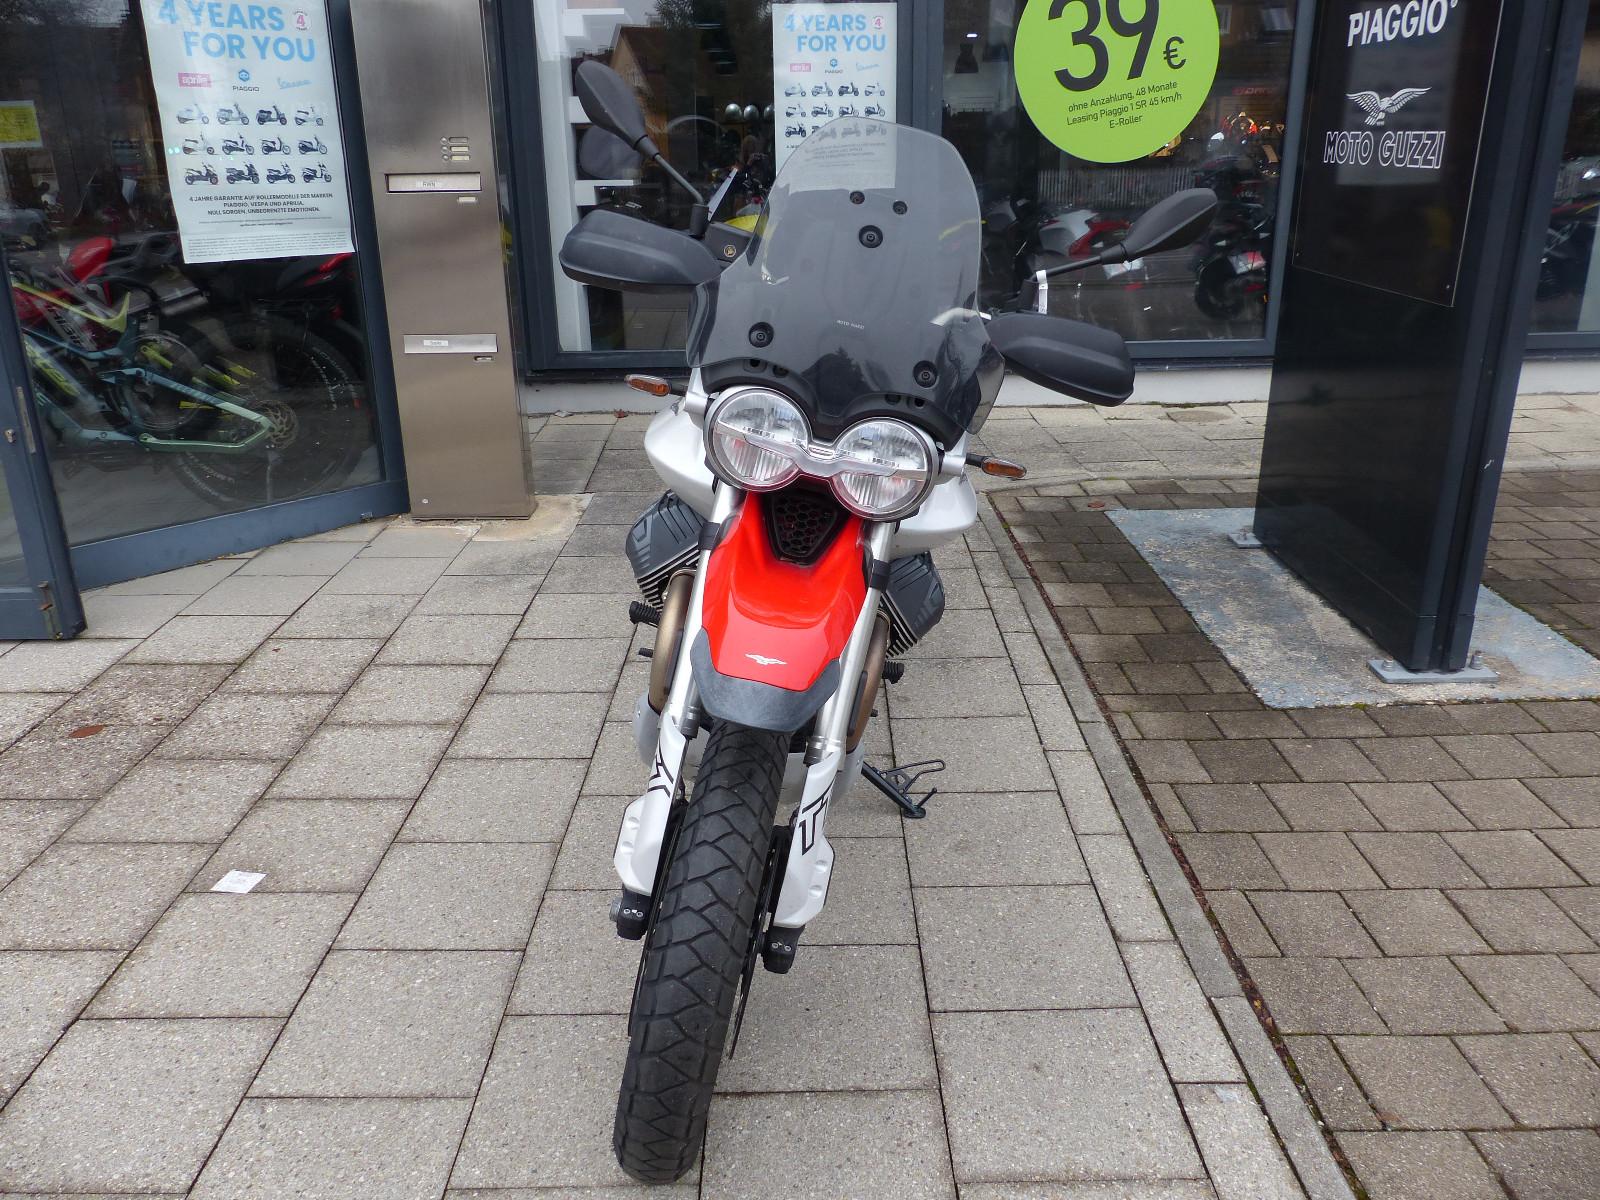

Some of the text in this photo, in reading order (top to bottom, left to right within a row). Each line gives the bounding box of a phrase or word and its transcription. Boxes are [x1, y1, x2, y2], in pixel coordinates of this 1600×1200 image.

[159, 0, 285, 32] 4 YEARS
[785, 14, 867, 32] 4 YEARS
[1347, 0, 1449, 47] PIAGGIO
[183, 31, 316, 63] FOR YOU
[797, 34, 887, 52] FOR YOU
[1047, 0, 1187, 92] 39 €
[1066, 112, 1099, 126] Leasing
[1099, 105, 1129, 118] Piaggio
[1135, 100, 1147, 110] SR
[1149, 96, 1159, 107] 45
[1160, 92, 1183, 104] km/h
[1068, 81, 1178, 113] ohne Anzahlung, 48 Monate
[1109, 115, 1143, 129] E-Roller
[1323, 131, 1446, 169] MOTO GUZZI
